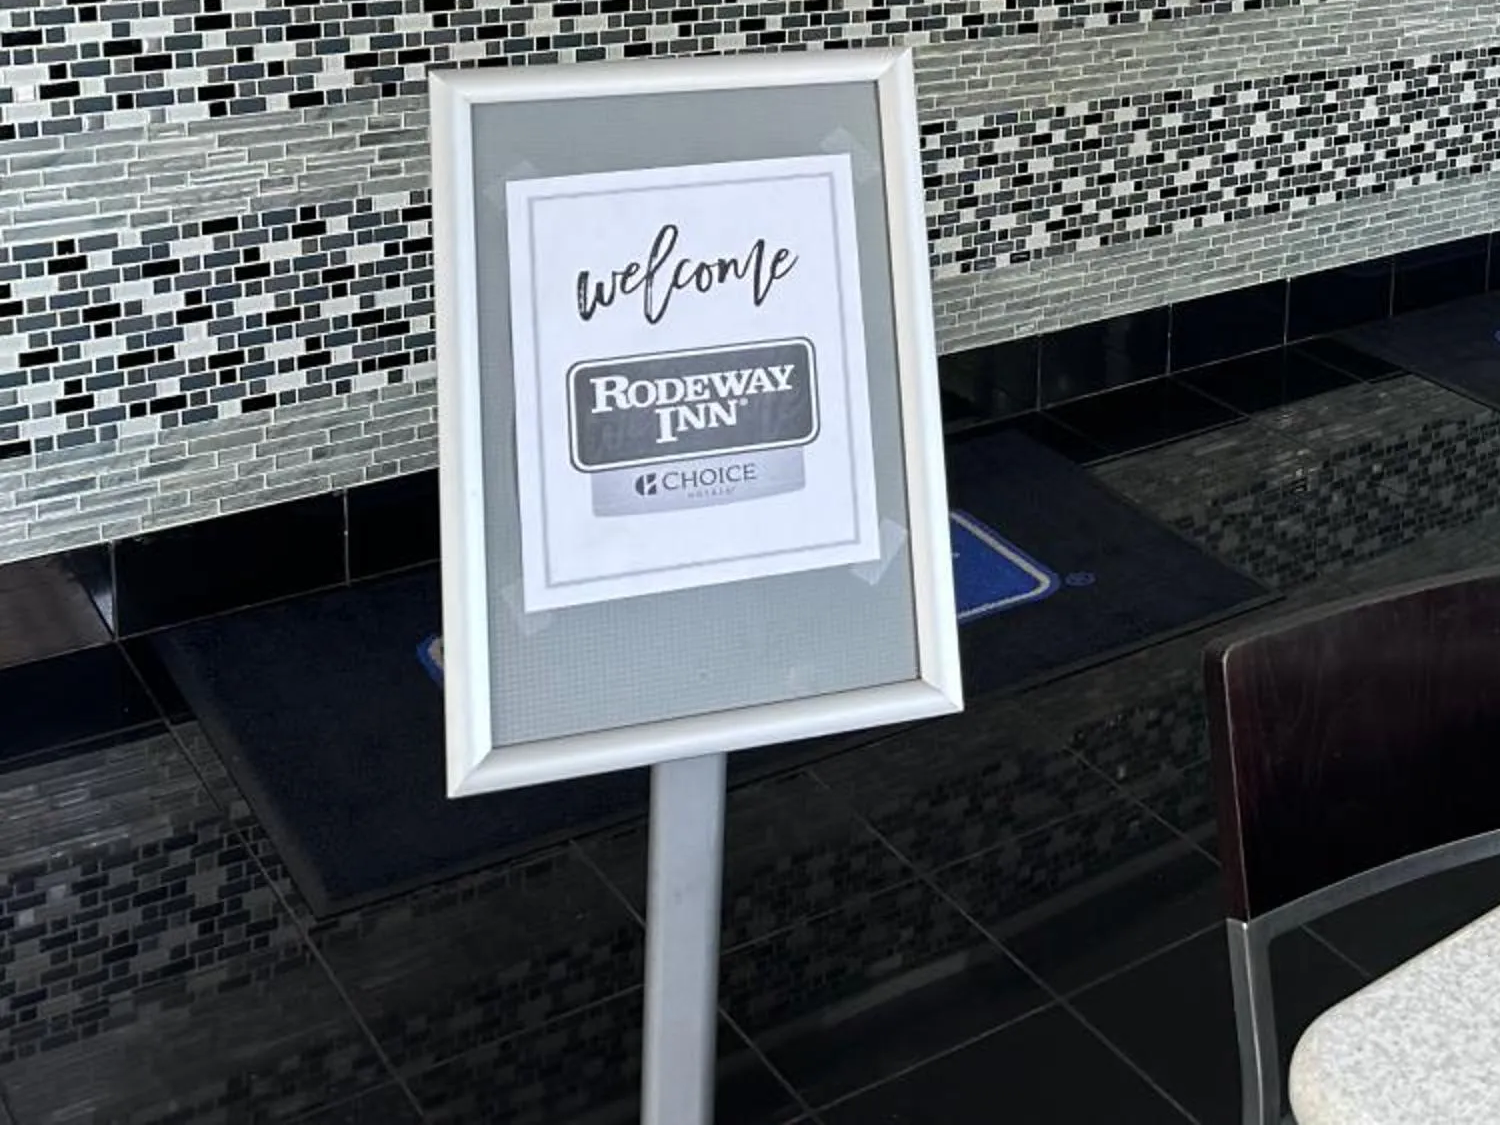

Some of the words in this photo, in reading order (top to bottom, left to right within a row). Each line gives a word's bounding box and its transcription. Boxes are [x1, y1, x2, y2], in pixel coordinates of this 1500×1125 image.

[576, 224, 799, 325] welcome
[589, 364, 796, 414] RODEWAY
[655, 399, 738, 444] INN
[661, 463, 758, 491] CHOICE
